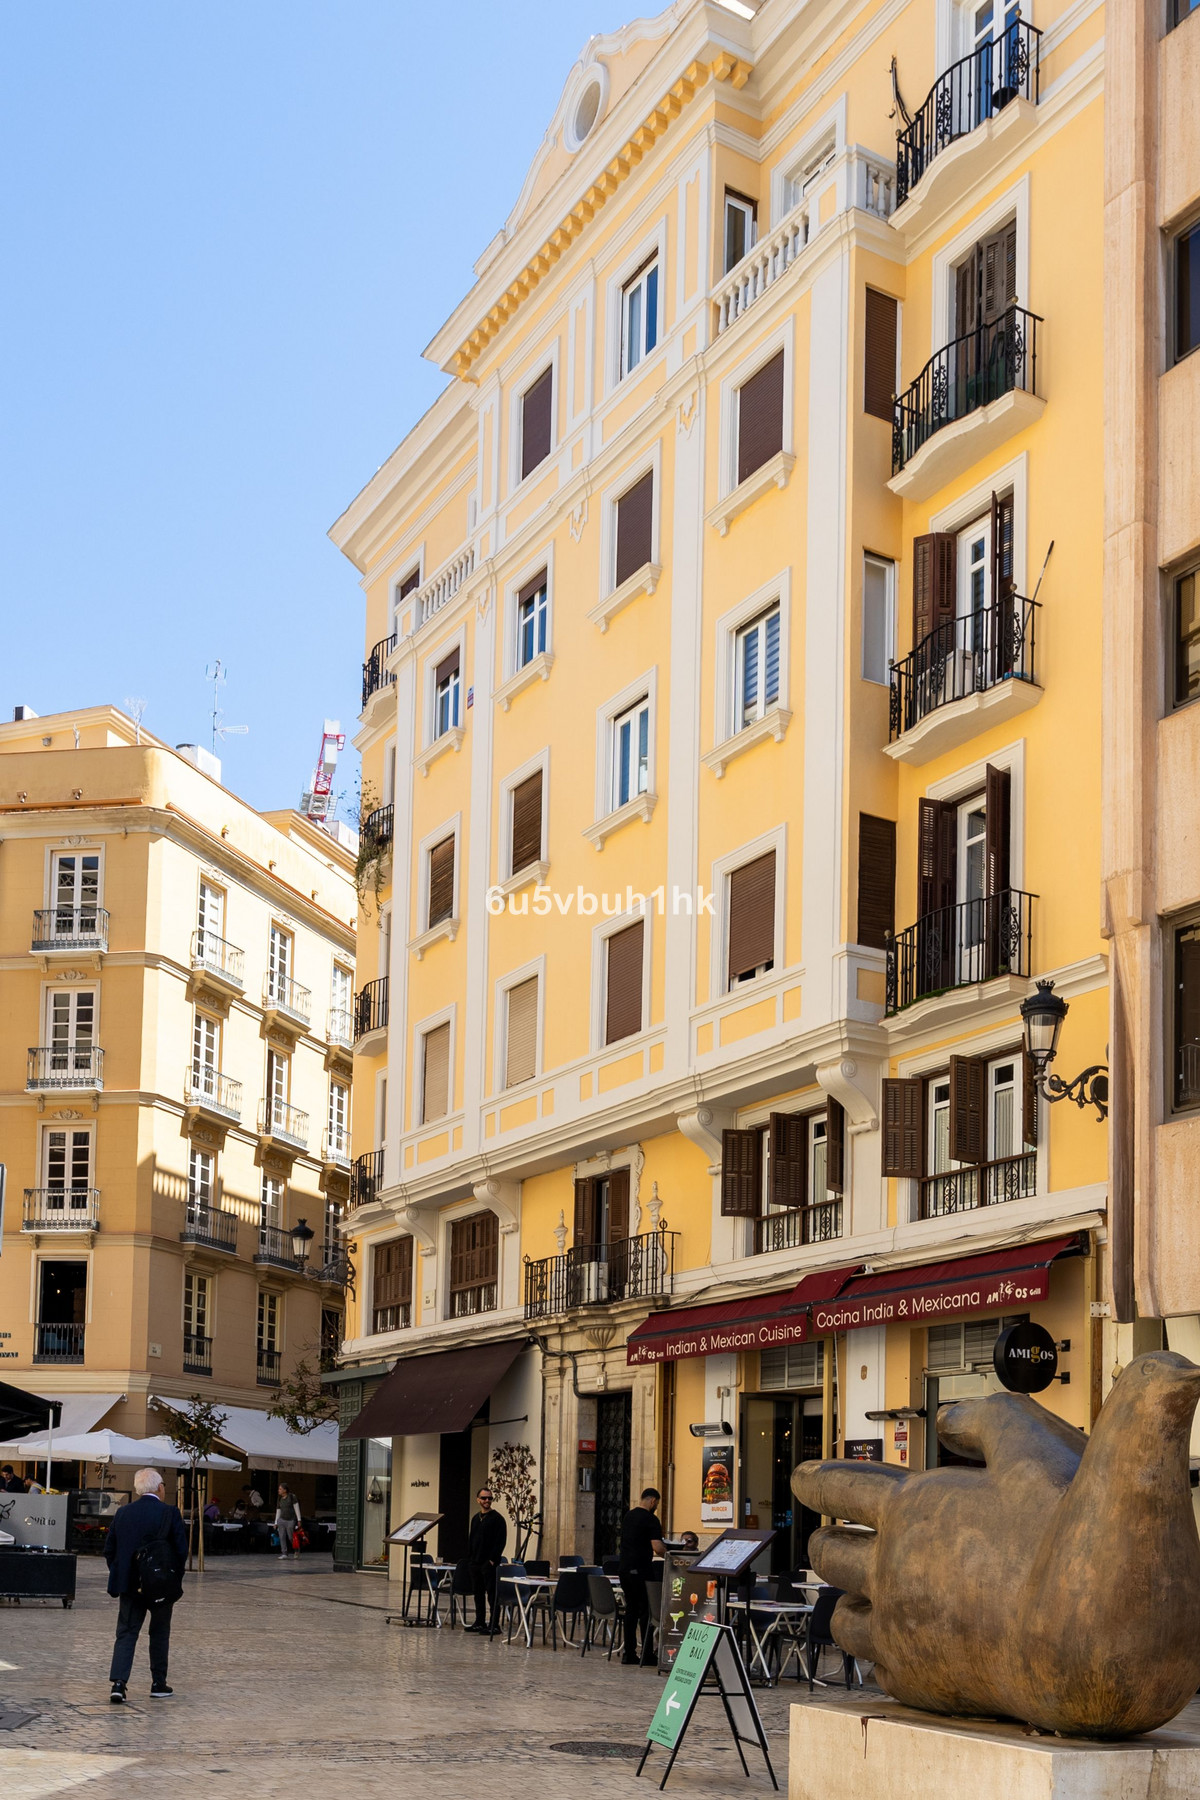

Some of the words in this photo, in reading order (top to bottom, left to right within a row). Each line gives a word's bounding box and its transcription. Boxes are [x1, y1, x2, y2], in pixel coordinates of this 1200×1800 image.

[816, 1309, 860, 1328] Cocina
[863, 1303, 894, 1322] India
[897, 1299, 909, 1316] &
[912, 1291, 980, 1315] Mexicana
[666, 1340, 697, 1357] Indian
[700, 1336, 708, 1352] &
[710, 1332, 756, 1350] Mexican
[758, 1325, 802, 1342] Cuisine
[687, 1628, 702, 1642] BALI
[689, 1646, 705, 1660] BALI
